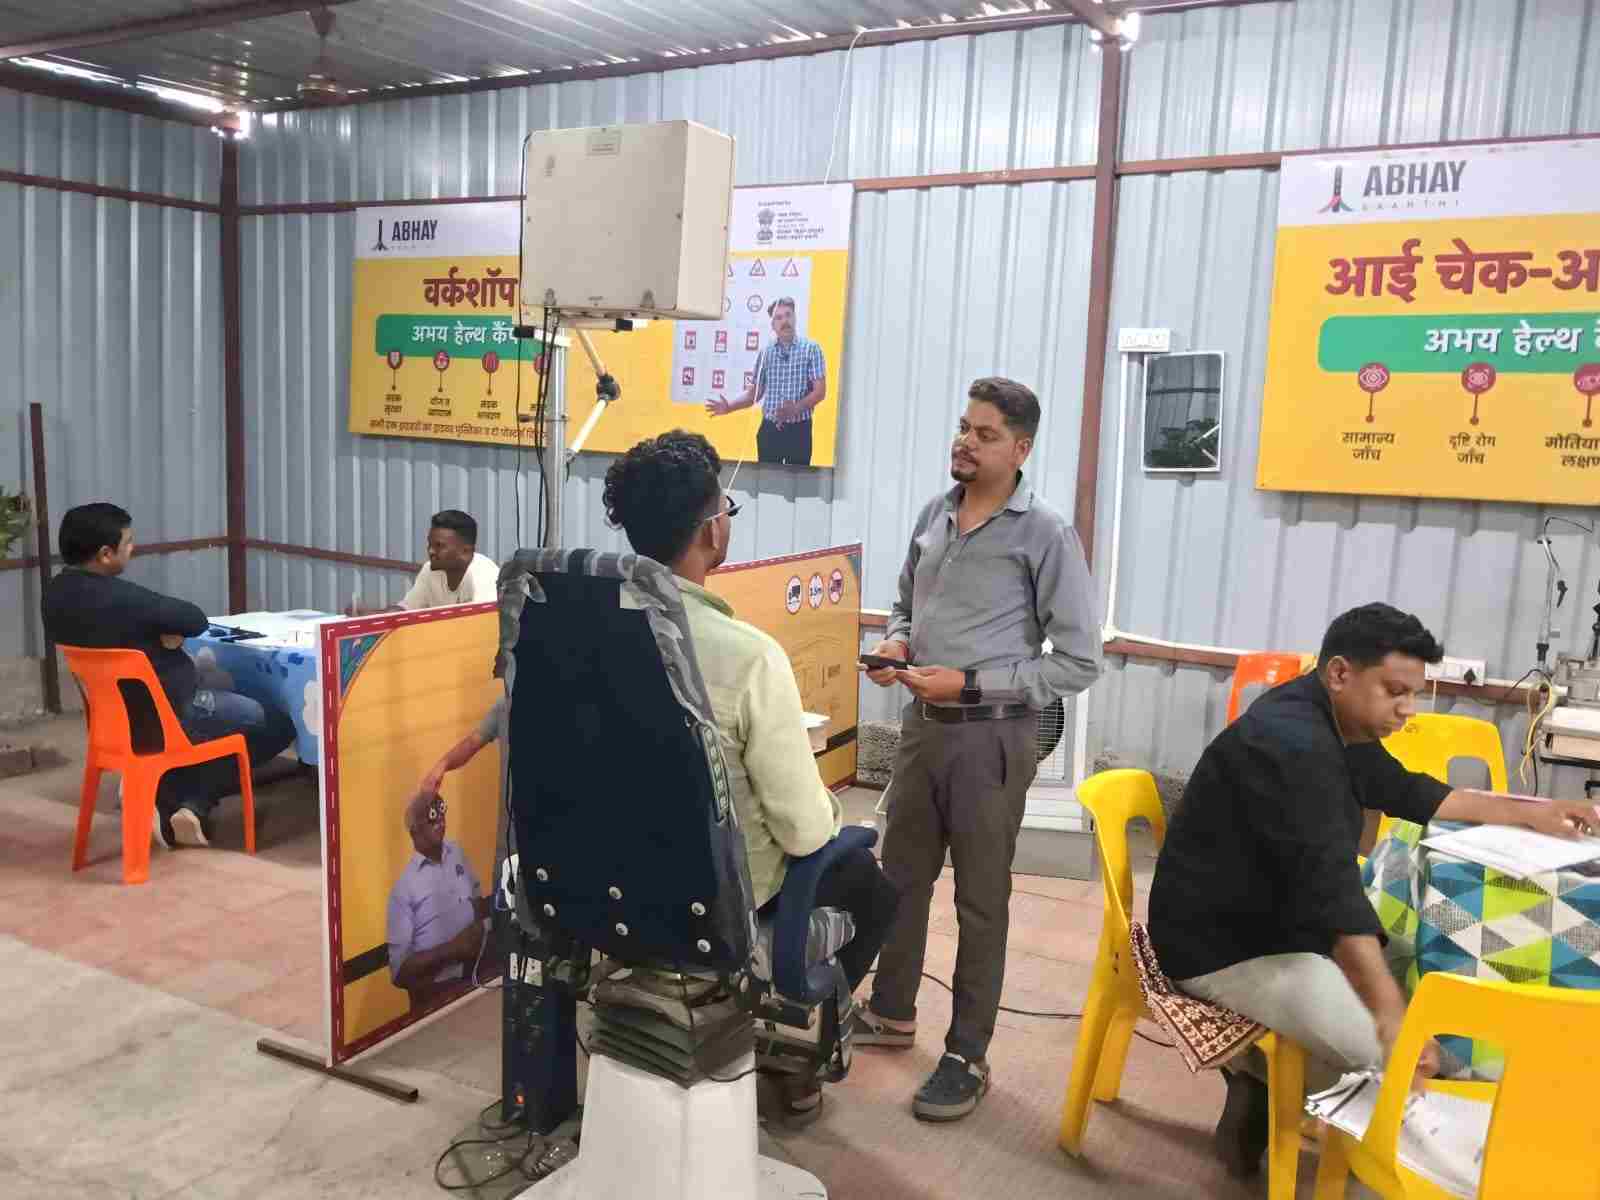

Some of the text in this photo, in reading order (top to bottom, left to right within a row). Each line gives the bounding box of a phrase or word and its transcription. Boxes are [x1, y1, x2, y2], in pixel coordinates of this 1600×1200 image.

[1363, 160, 1467, 197] ABHAY
[392, 220, 438, 242] ABHAY
[1324, 238, 1423, 303] आई
[423, 266, 518, 308] वर्कशॉप
[412, 325, 448, 343] अभय
[453, 321, 487, 345] हेल्थ
[1424, 327, 1503, 353] अभय
[1512, 320, 1583, 356] हेल्थ
[1341, 431, 1395, 445] सामान्य
[1475, 433, 1496, 447] रोग
